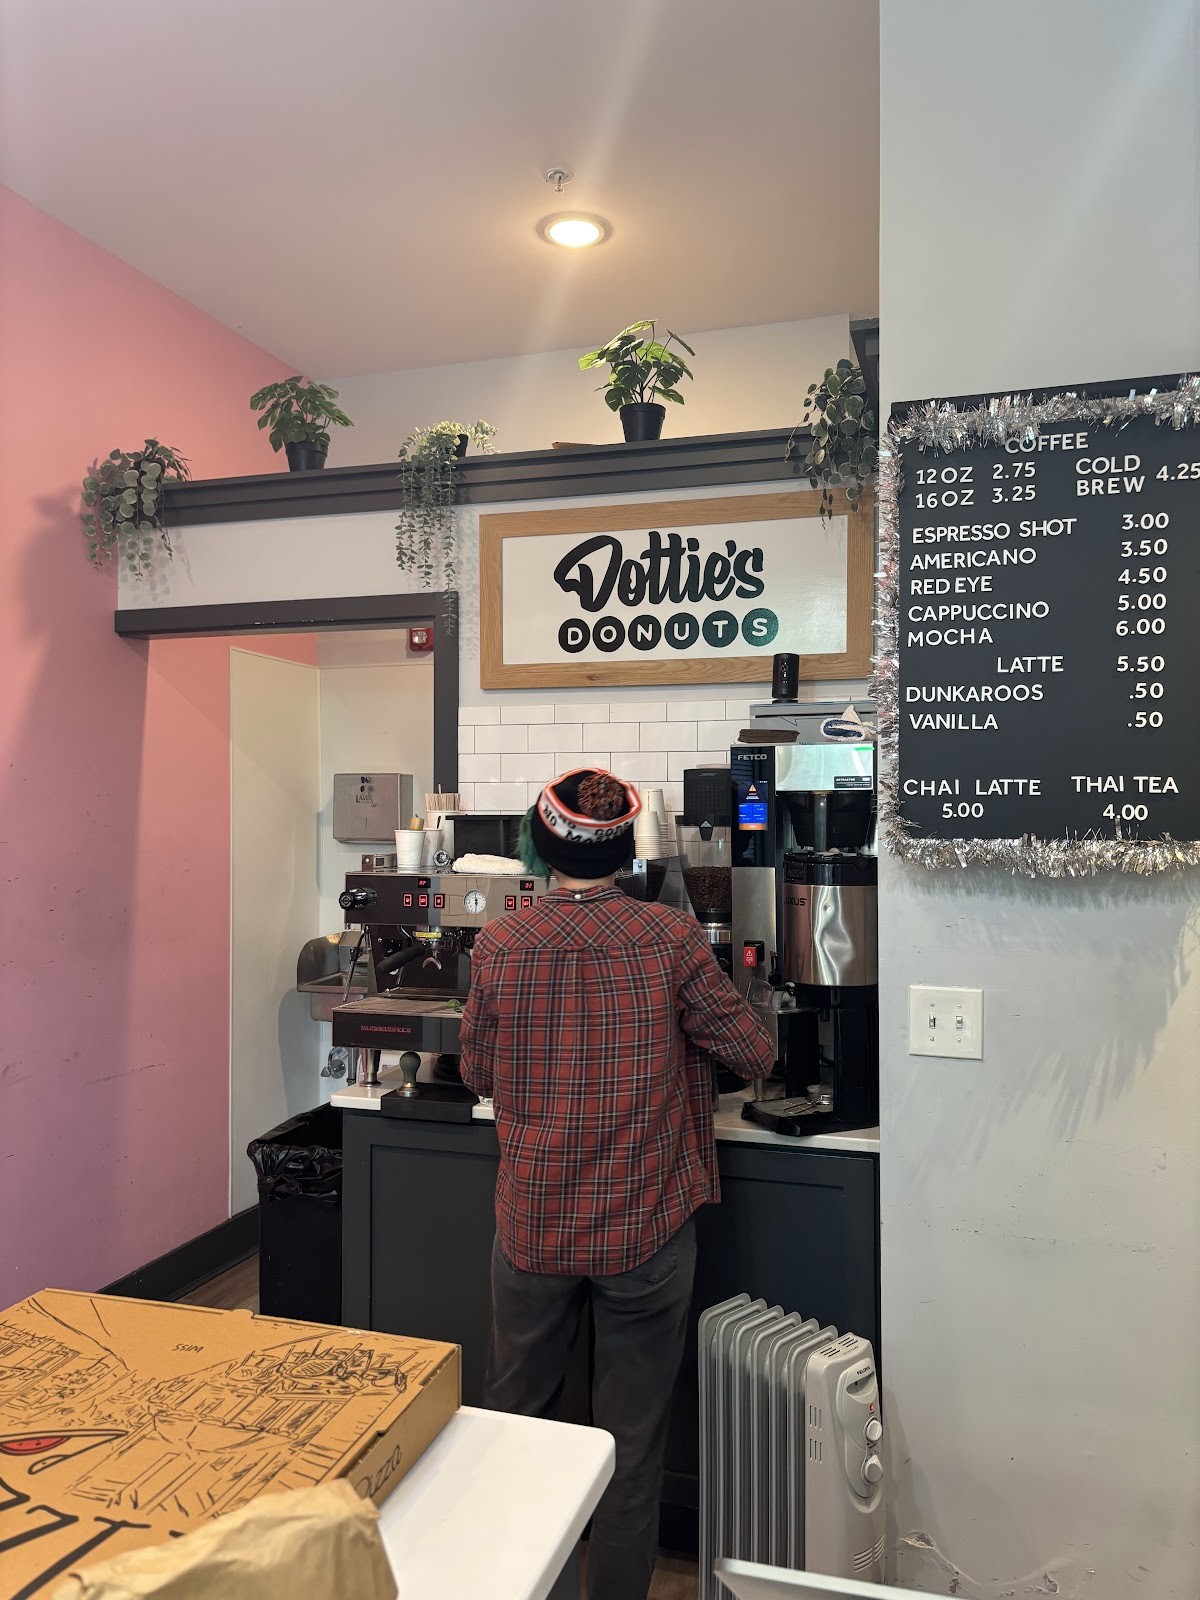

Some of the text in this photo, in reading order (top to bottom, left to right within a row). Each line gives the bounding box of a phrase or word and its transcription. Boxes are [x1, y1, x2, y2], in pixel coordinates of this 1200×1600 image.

[1004, 432, 1088, 454] COFFEE
[991, 461, 1036, 480] 2.75
[1075, 454, 1141, 475] COLD
[1155, 462, 1200, 482] 4.25
[991, 484, 1036, 503] 3.25
[1076, 475, 1145, 496] BREW
[912, 518, 1077, 544] ESPRESSO SHOT
[1121, 512, 1170, 531] 3.00
[1120, 538, 1168, 558] 3.50
[909, 547, 1036, 570] AMERICANO
[553, 531, 765, 613] Dottie's
[1117, 566, 1168, 585] 4.50
[910, 576, 993, 595] RED EYE
[908, 601, 1050, 622] CAPPUCCINO
[1117, 593, 1167, 612] 5.00
[558, 607, 779, 654] DONUTS
[1115, 618, 1166, 637] 6.00
[907, 628, 993, 648] MOCHA
[996, 656, 1065, 674] LATTE
[1116, 655, 1165, 673] 5.50
[906, 684, 1044, 703] DUNKAROOS
[1129, 682, 1164, 700] .50
[908, 713, 999, 730] VANILLA
[1127, 711, 1164, 728] .50
[737, 753, 768, 761] FETCO
[903, 778, 1042, 796] CHAI LATTE
[1071, 776, 1180, 794] THAI TEA
[941, 802, 985, 819] 5.00
[1102, 804, 1149, 821] 4.00
